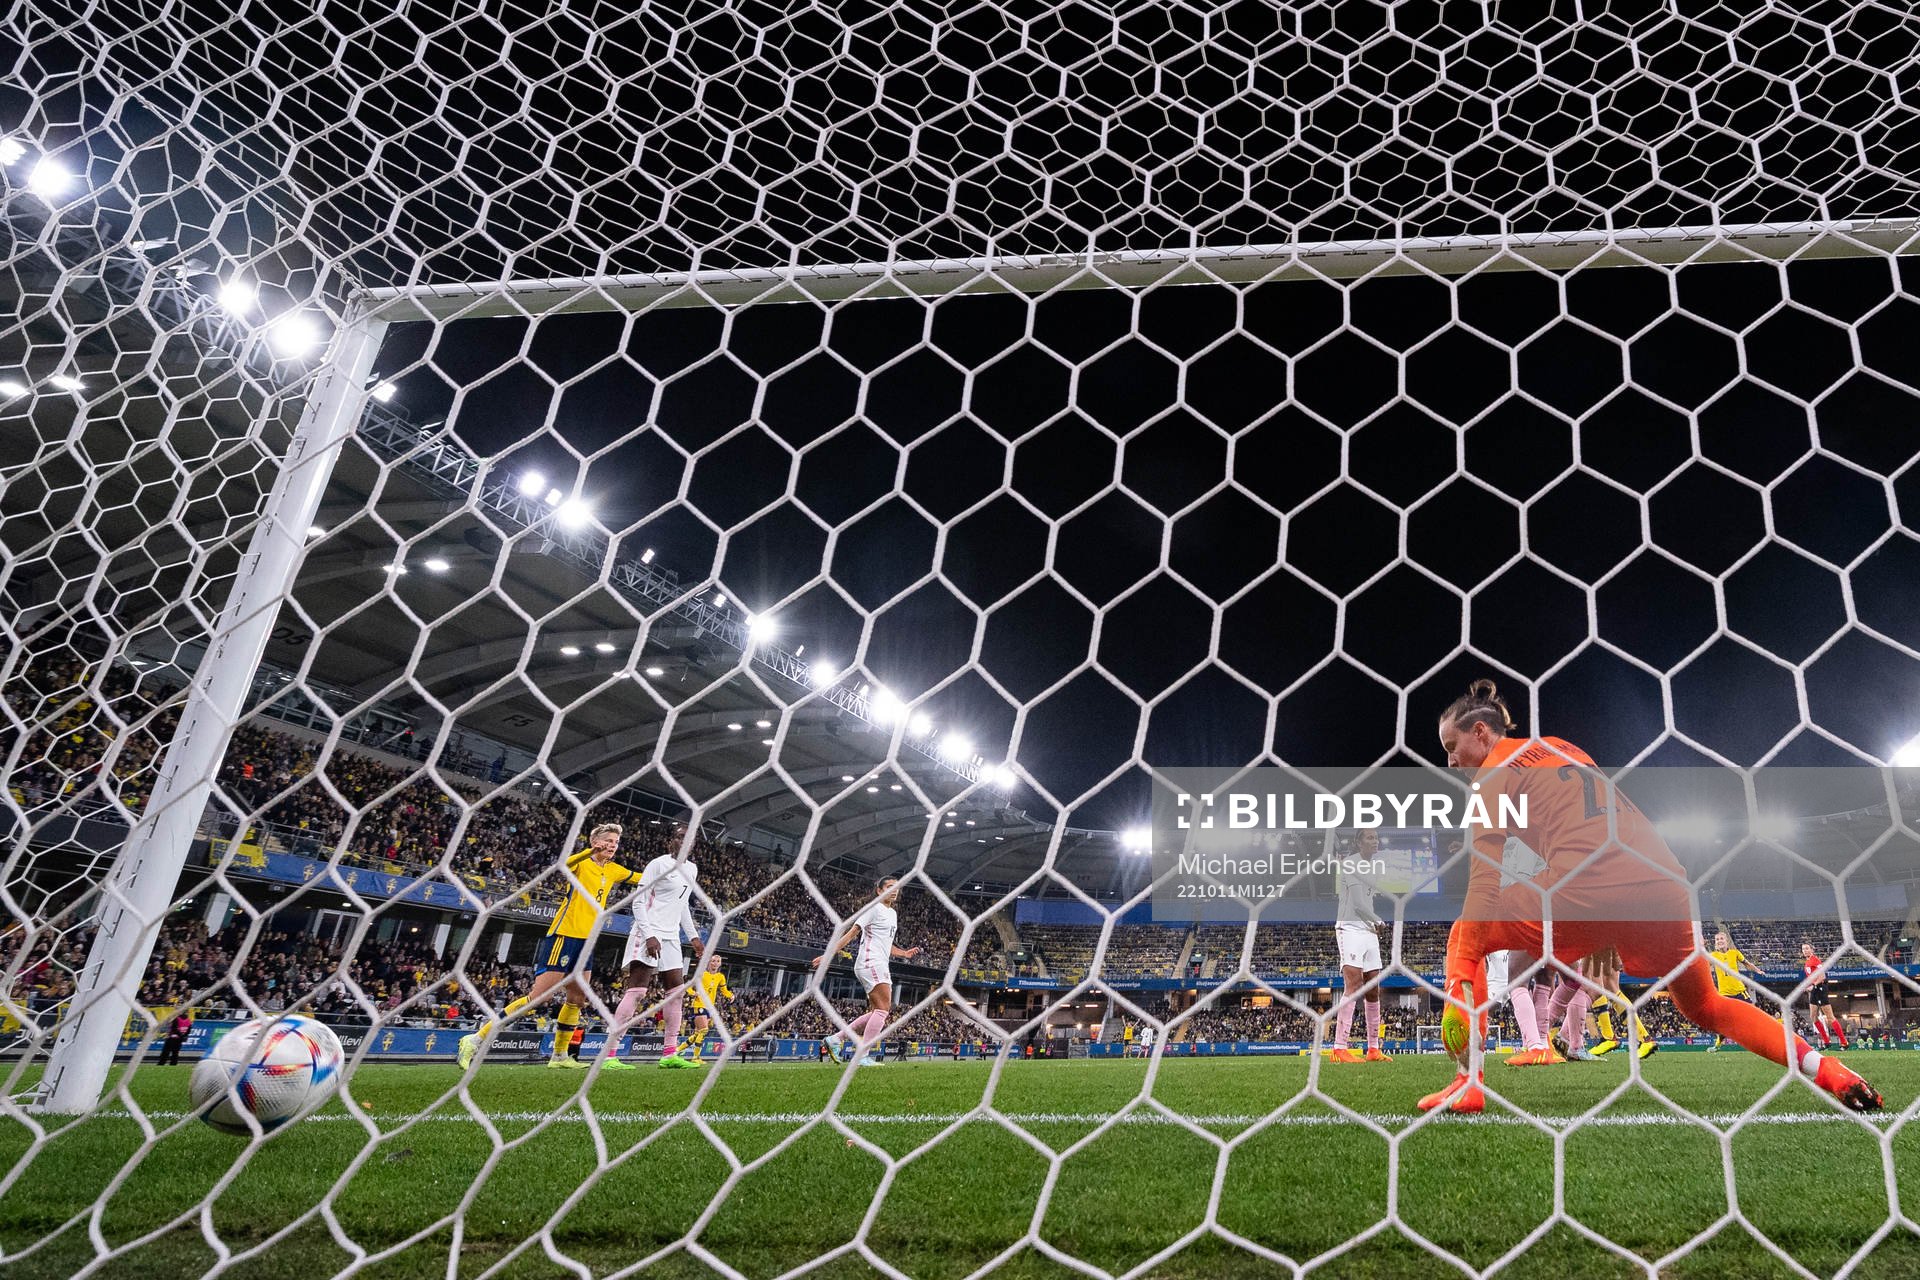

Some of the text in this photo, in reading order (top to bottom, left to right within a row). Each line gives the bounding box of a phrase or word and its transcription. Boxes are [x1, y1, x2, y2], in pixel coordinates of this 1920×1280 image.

[503, 713, 534, 727] F5
[596, 888, 604, 903] 8
[678, 885, 688, 899] 7
[338, 1035, 363, 1046] llevi
[491, 1039, 517, 1049] Gamla
[518, 1040, 541, 1049] Ullevi
[632, 1042, 651, 1051] Gamla
[651, 1043, 665, 1051] Ulle
